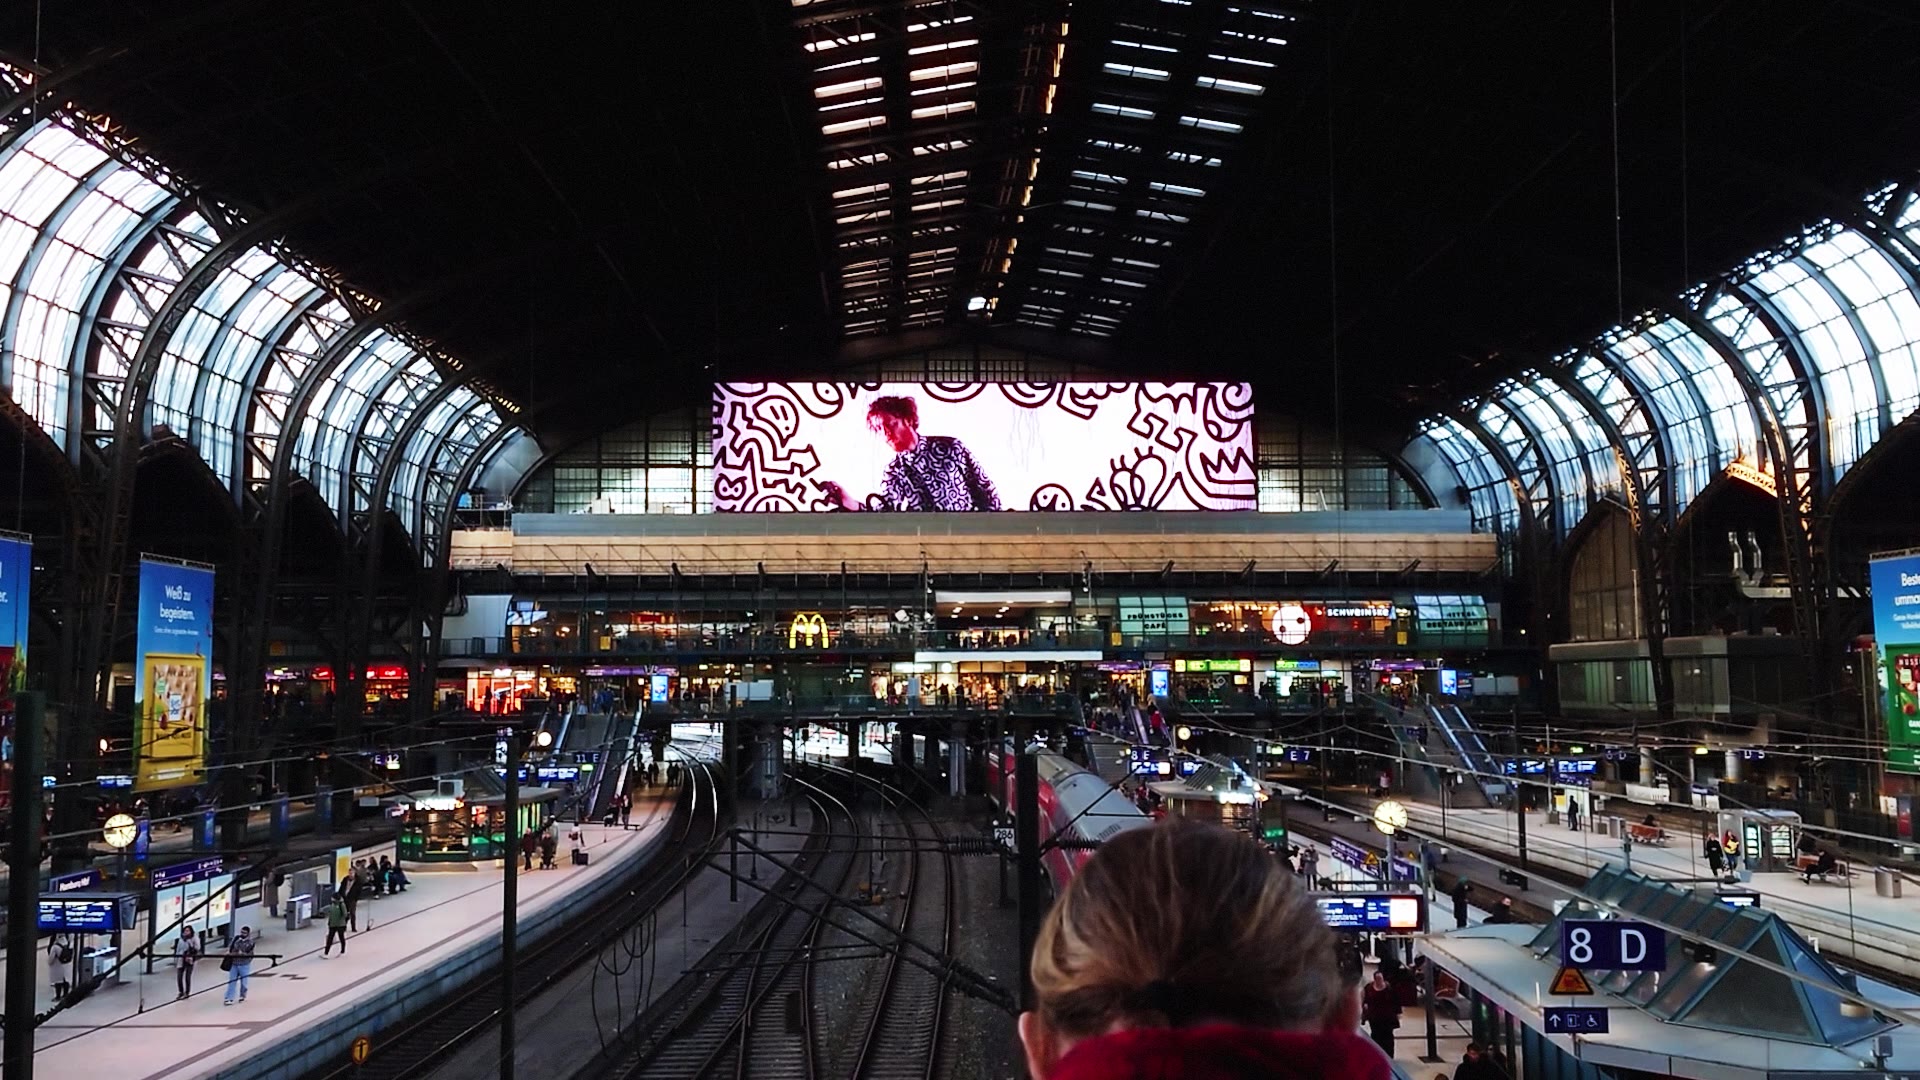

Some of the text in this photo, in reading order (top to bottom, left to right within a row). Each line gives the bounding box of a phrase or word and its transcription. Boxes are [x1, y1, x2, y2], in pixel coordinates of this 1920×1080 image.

[164, 585, 183, 600] Weiß
[1327, 608, 1390, 617] SCHWEINSKE
[374, 754, 400, 765] E 12
[575, 754, 600, 763] 11 E
[1131, 750, 1150, 761] 8 E
[1290, 750, 1311, 761] E 7
[1569, 927, 1647, 964] 8 D
